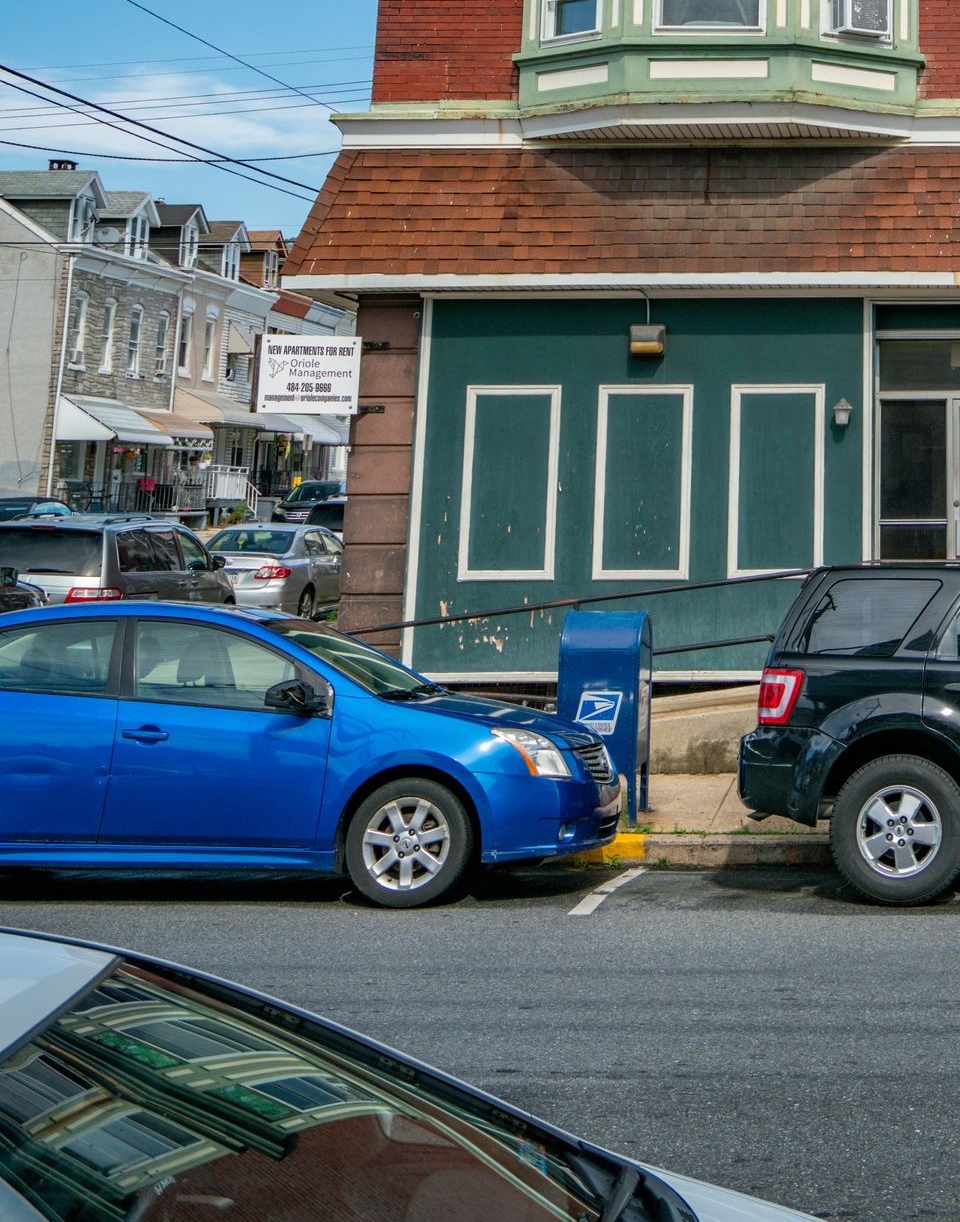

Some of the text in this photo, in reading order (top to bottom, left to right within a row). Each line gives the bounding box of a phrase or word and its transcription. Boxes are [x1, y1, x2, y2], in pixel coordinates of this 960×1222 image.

[267, 345, 355, 357] NEW APARTMENTS FOR RENT
[290, 358, 320, 368] Oriole
[289, 368, 352, 380] Management
